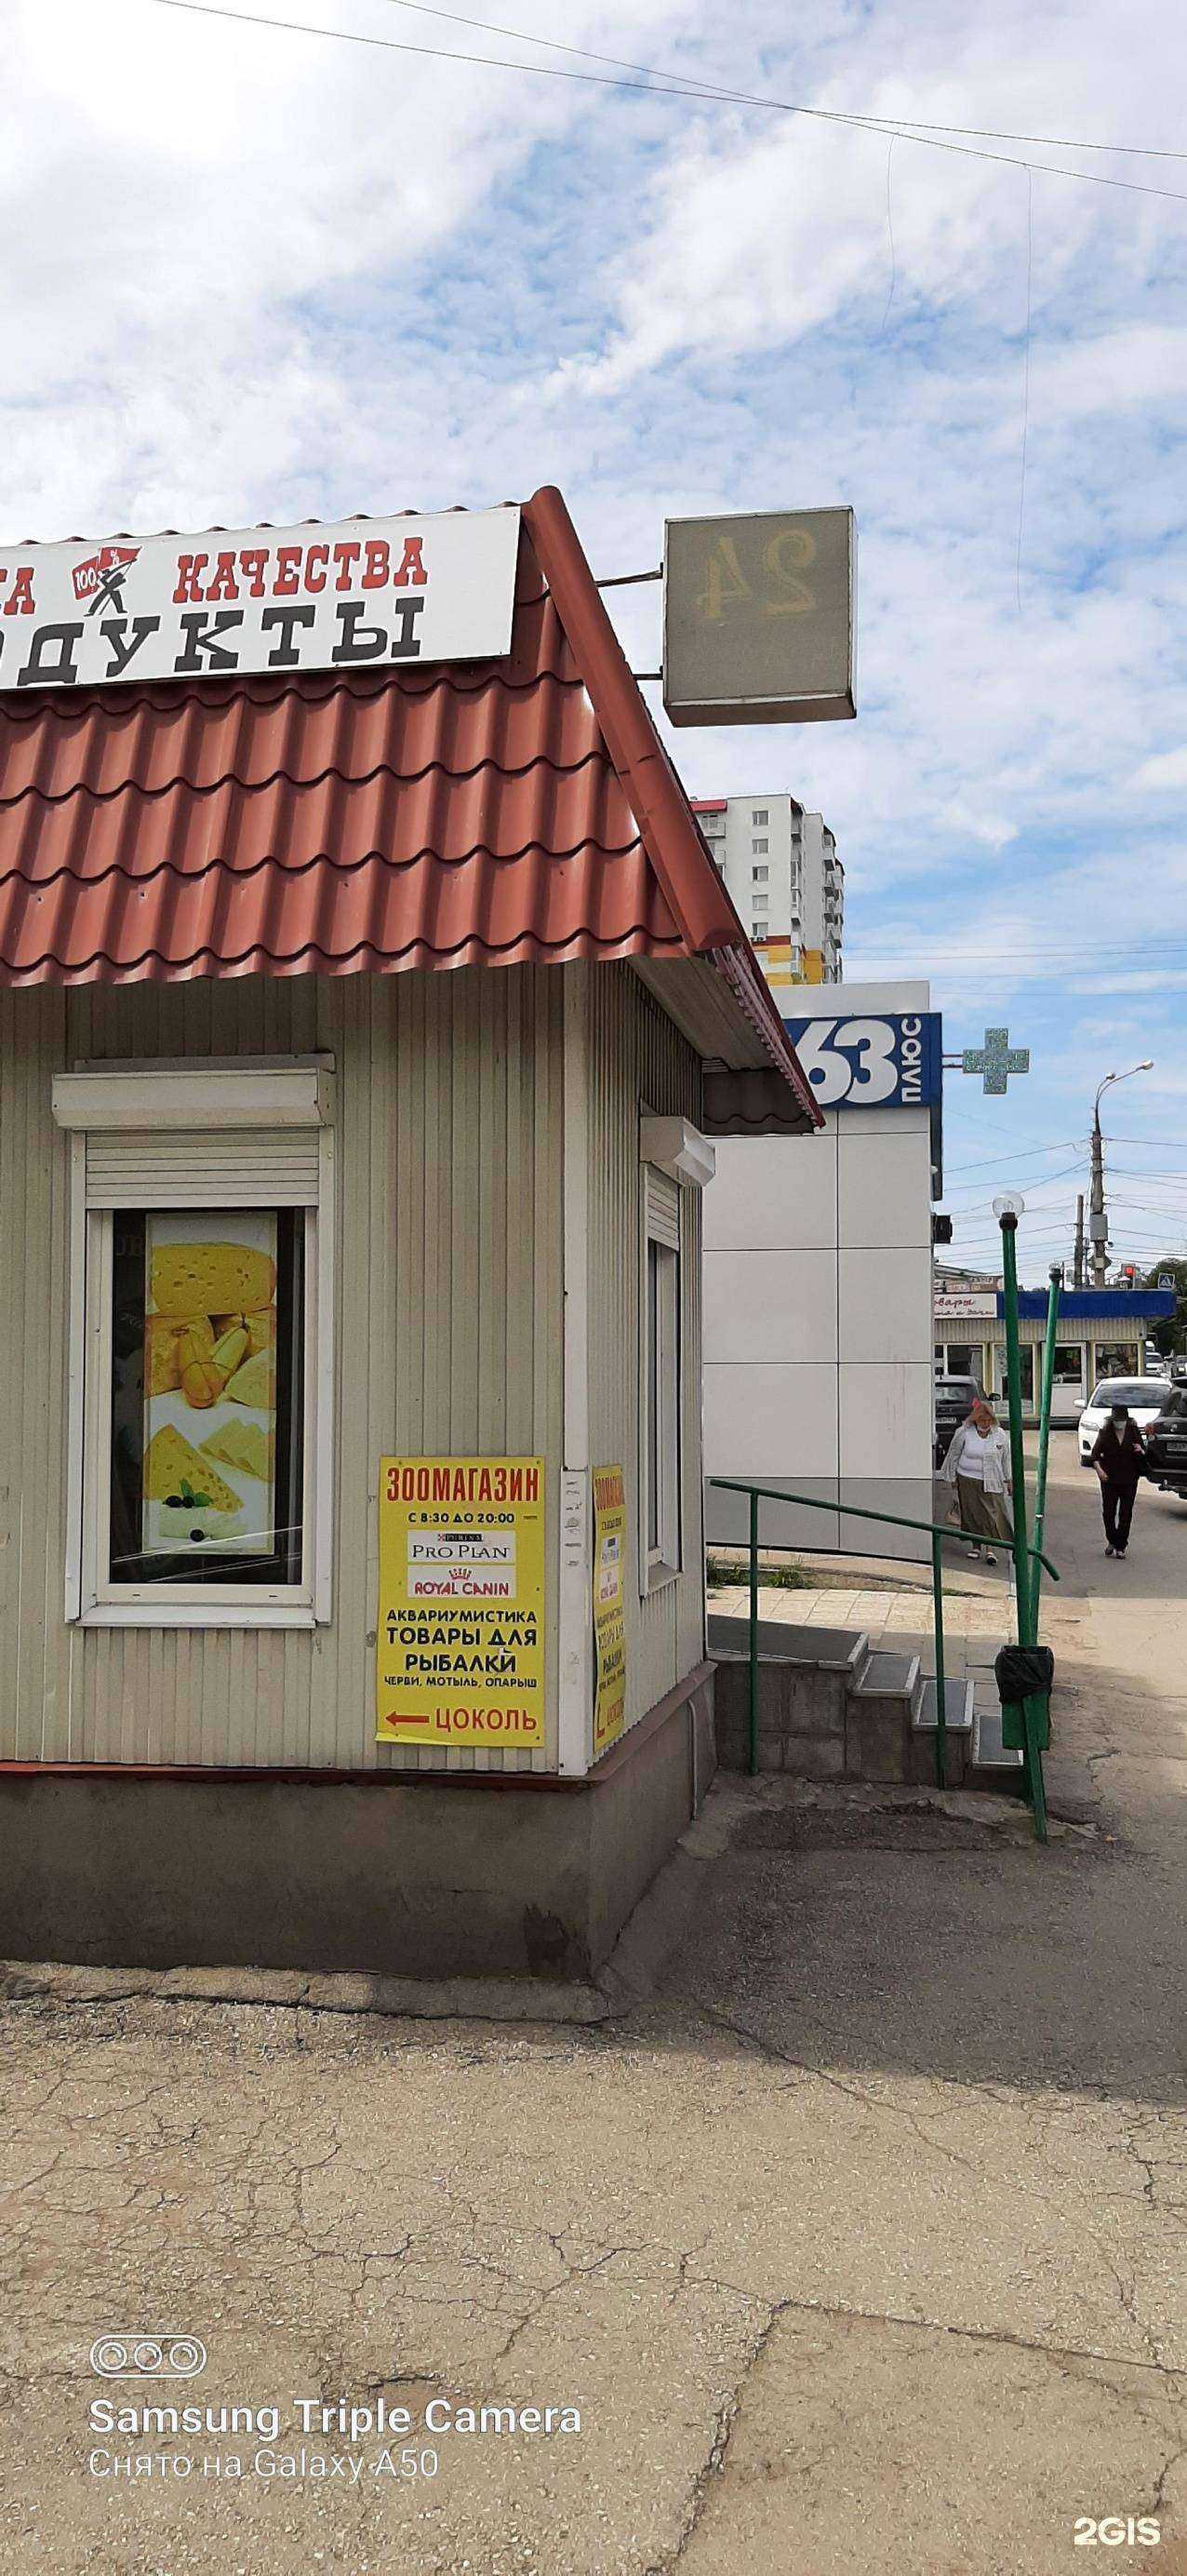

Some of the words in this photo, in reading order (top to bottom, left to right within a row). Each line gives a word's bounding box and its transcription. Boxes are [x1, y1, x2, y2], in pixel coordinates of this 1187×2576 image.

[172, 537, 428, 603] КАЧЕСТВА
[0, 597, 425, 687] ДУКТЫ
[795, 1019, 898, 1105] 63
[900, 1018, 922, 1102] ПЛЮС
[387, 1467, 539, 1501] ЗООМАГАЗИН
[408, 1513, 417, 1523] С
[420, 1513, 449, 1523] 8:30
[453, 1513, 473, 1523] ДО
[477, 1513, 514, 1523] 20:00
[446, 1534, 483, 1542] PURINA
[414, 1582, 459, 1595] ROYAL
[462, 1582, 509, 1595] CANIN
[386, 1609, 537, 1623] АКВАРИУМИСТИКА
[386, 1627, 480, 1645] ТОВАРЫ
[487, 1629, 537, 1646] ДЛЯ
[406, 1654, 516, 1672] РЫБАЛКИ
[384, 1677, 422, 1686] ЧЕРВИ,
[426, 1678, 481, 1688] МОТЫЛЬ,
[485, 1678, 537, 1688] ОПАРЫШ
[435, 1708, 537, 1732] ЦОКОЛЬ
